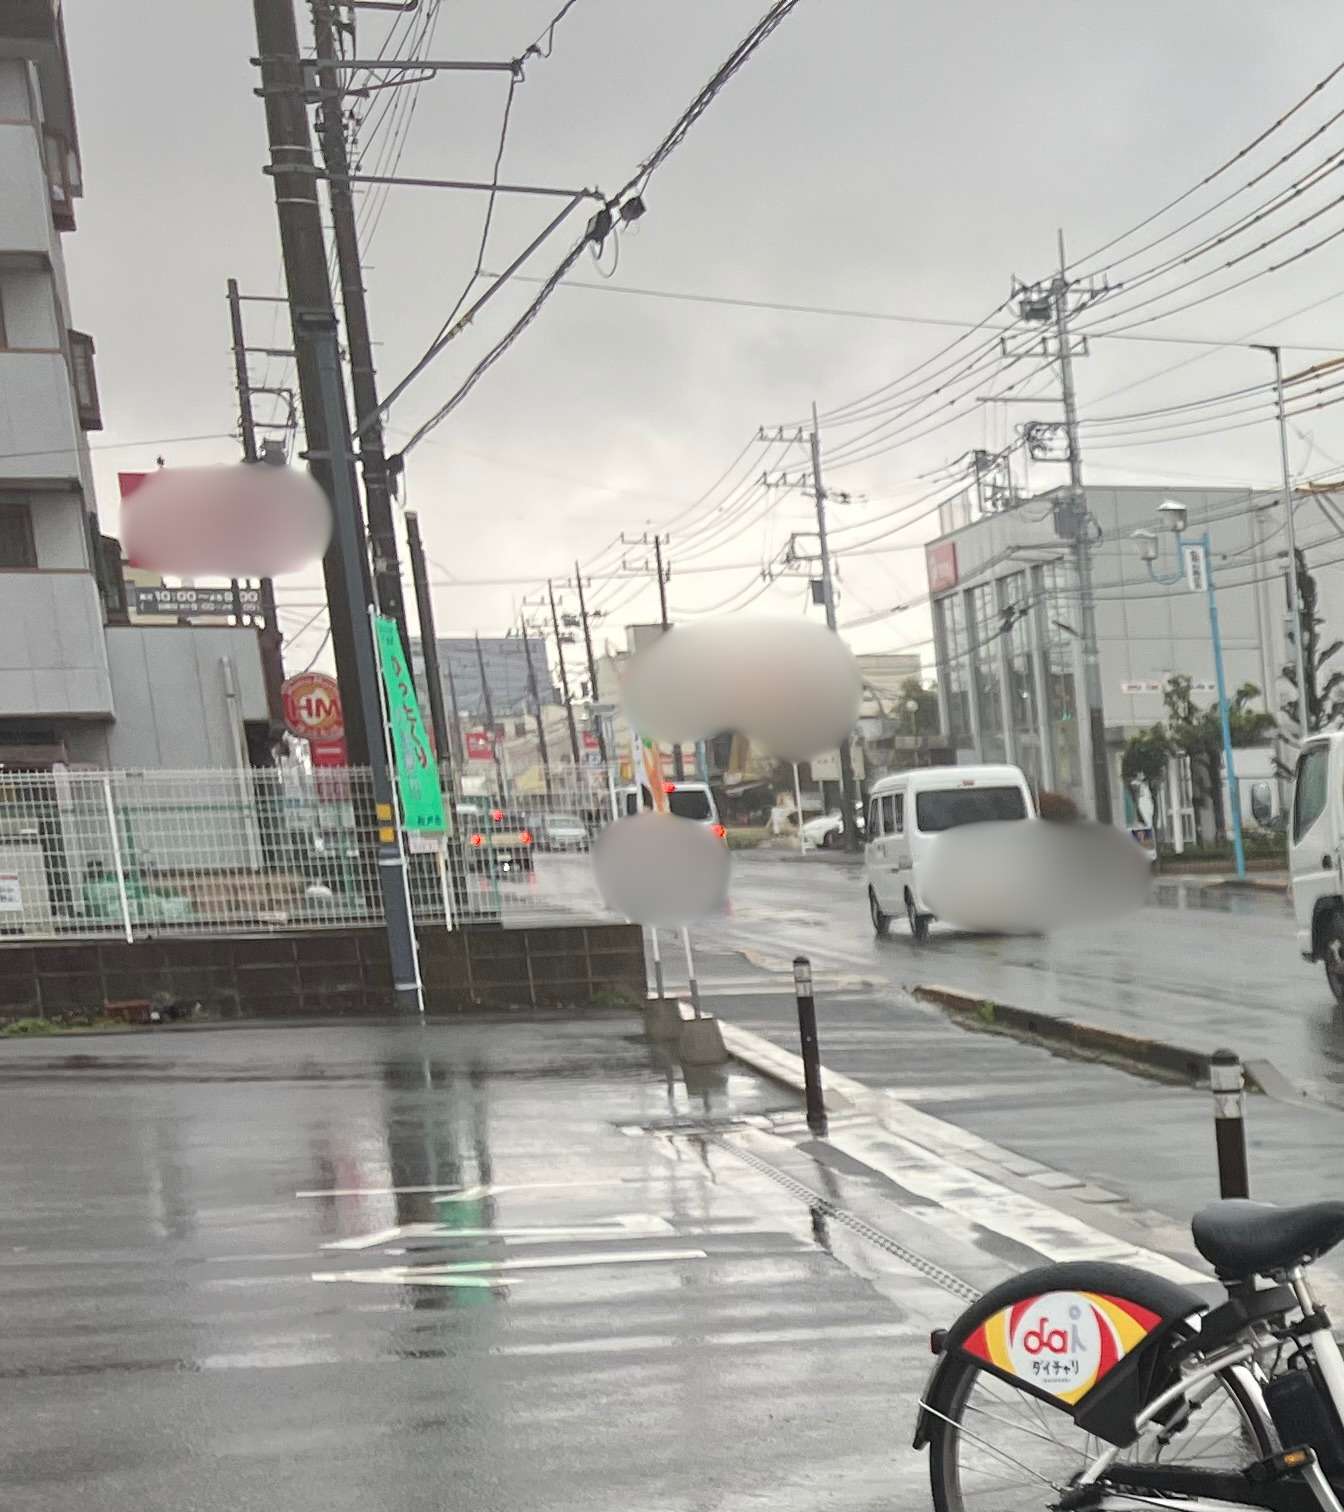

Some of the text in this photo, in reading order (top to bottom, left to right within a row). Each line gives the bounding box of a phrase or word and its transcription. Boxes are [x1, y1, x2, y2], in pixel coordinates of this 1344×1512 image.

[1023, 1305, 1087, 1354] dai
[1032, 1360, 1079, 1376] ダイチャリ
